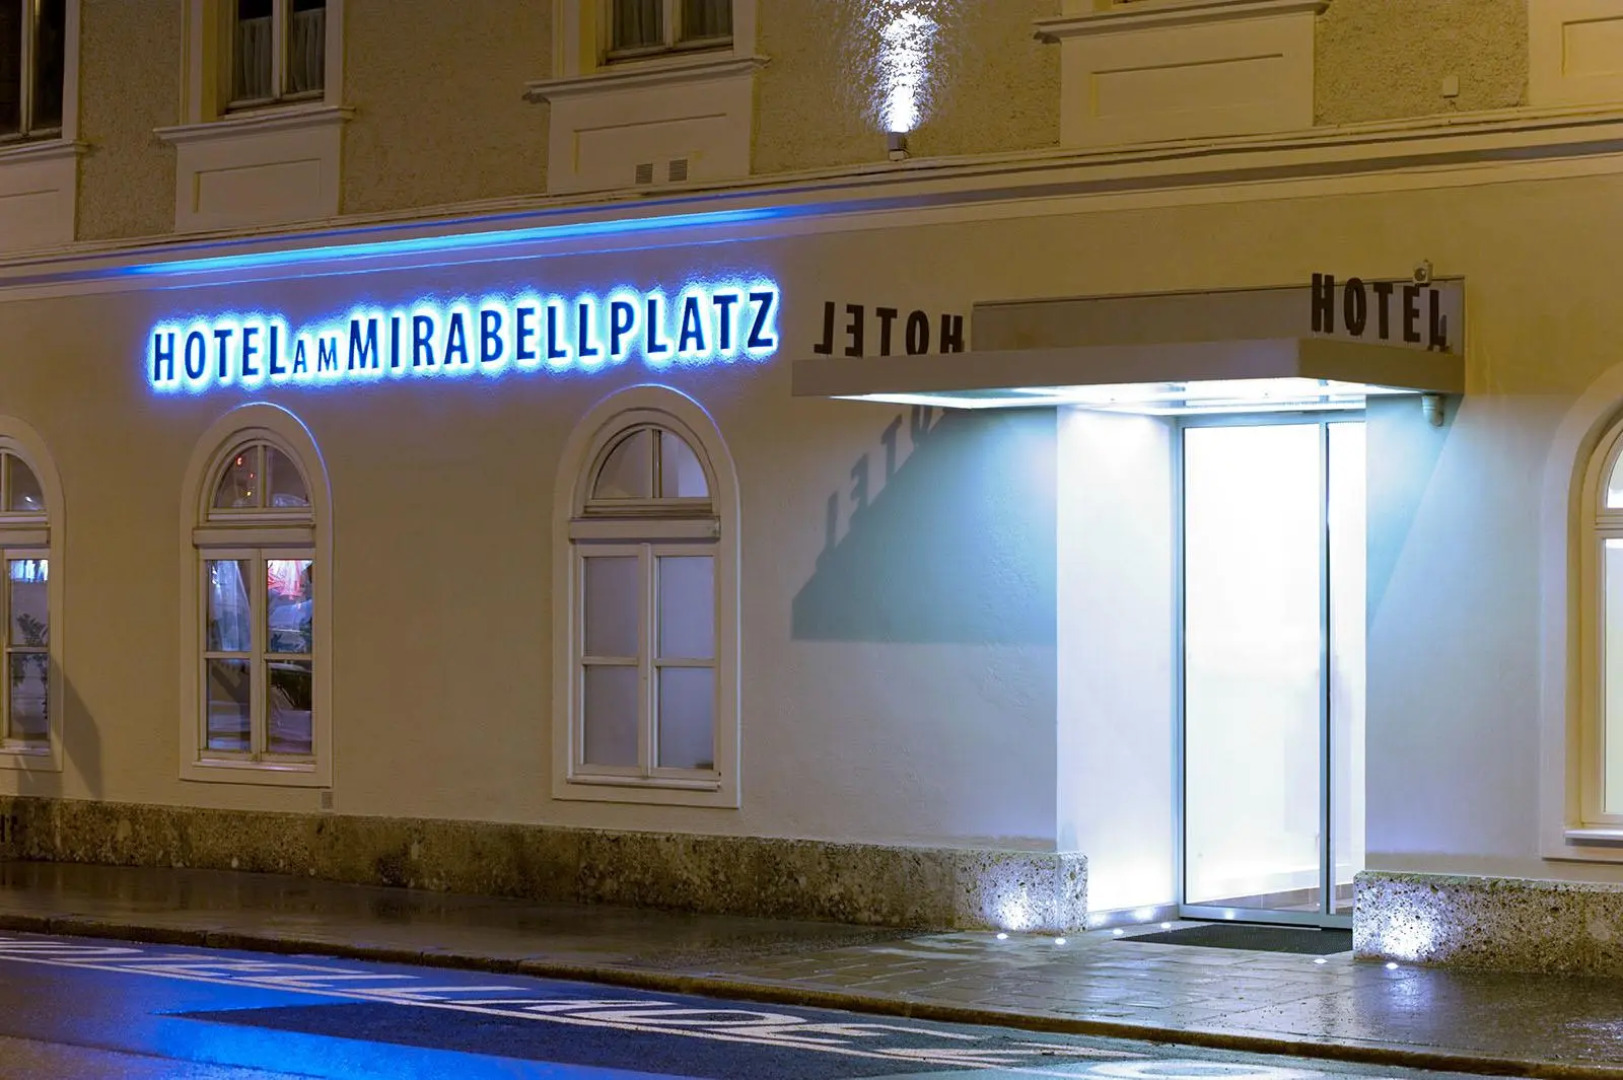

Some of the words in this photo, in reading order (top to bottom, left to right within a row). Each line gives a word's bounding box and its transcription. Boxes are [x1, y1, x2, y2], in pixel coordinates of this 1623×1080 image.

[153, 325, 286, 381] HOTEL
[293, 337, 338, 374] AM
[348, 292, 774, 371] MIRABELLPLATZ
[1311, 273, 1448, 347] HOTEL
